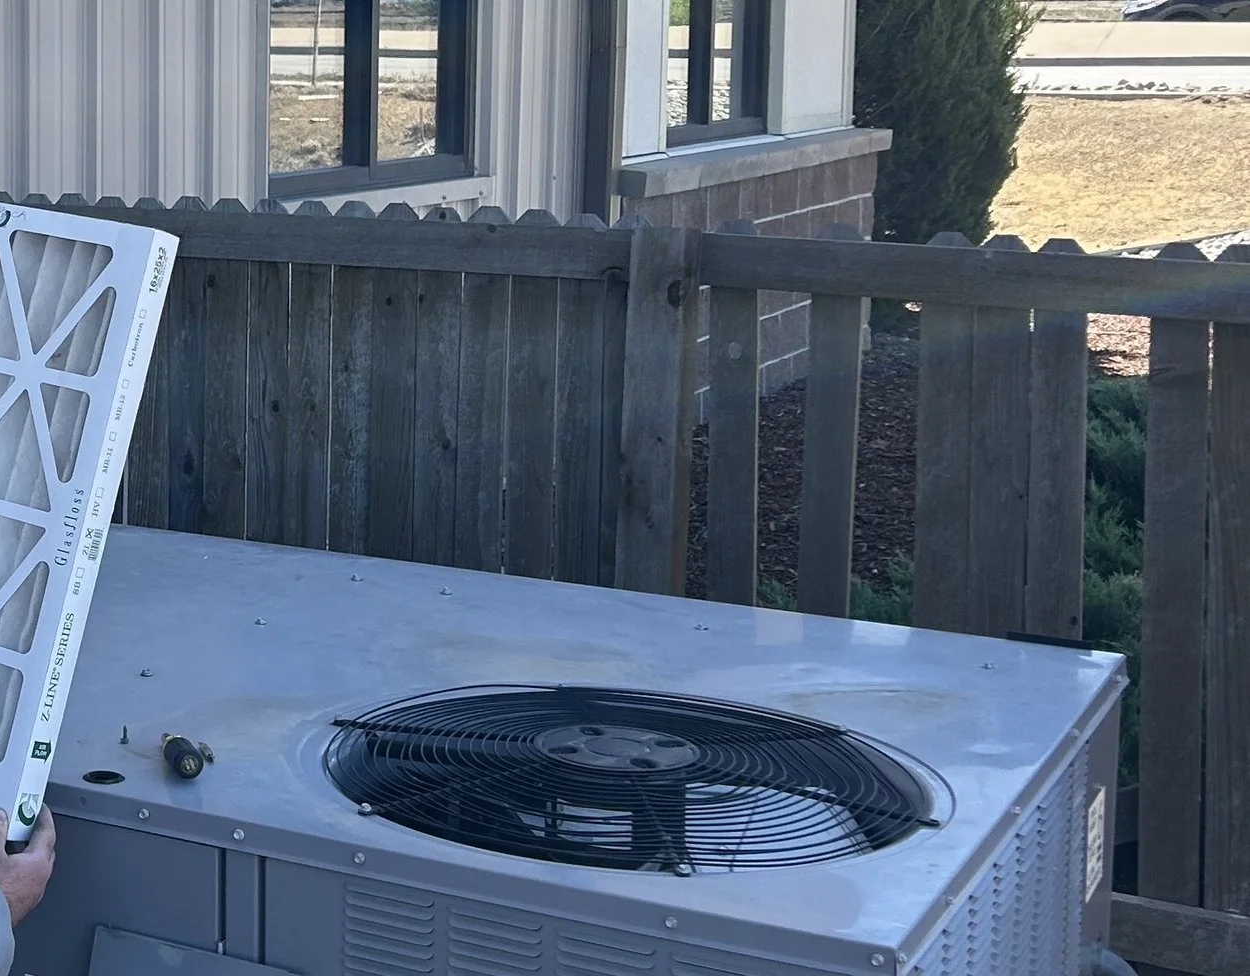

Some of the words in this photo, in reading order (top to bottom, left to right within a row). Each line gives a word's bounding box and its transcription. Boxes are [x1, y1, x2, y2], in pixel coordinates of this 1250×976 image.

[149, 246, 167, 294] 16x25x2
[54, 488, 85, 566] Glasfloss
[55, 612, 75, 667] SERIES
